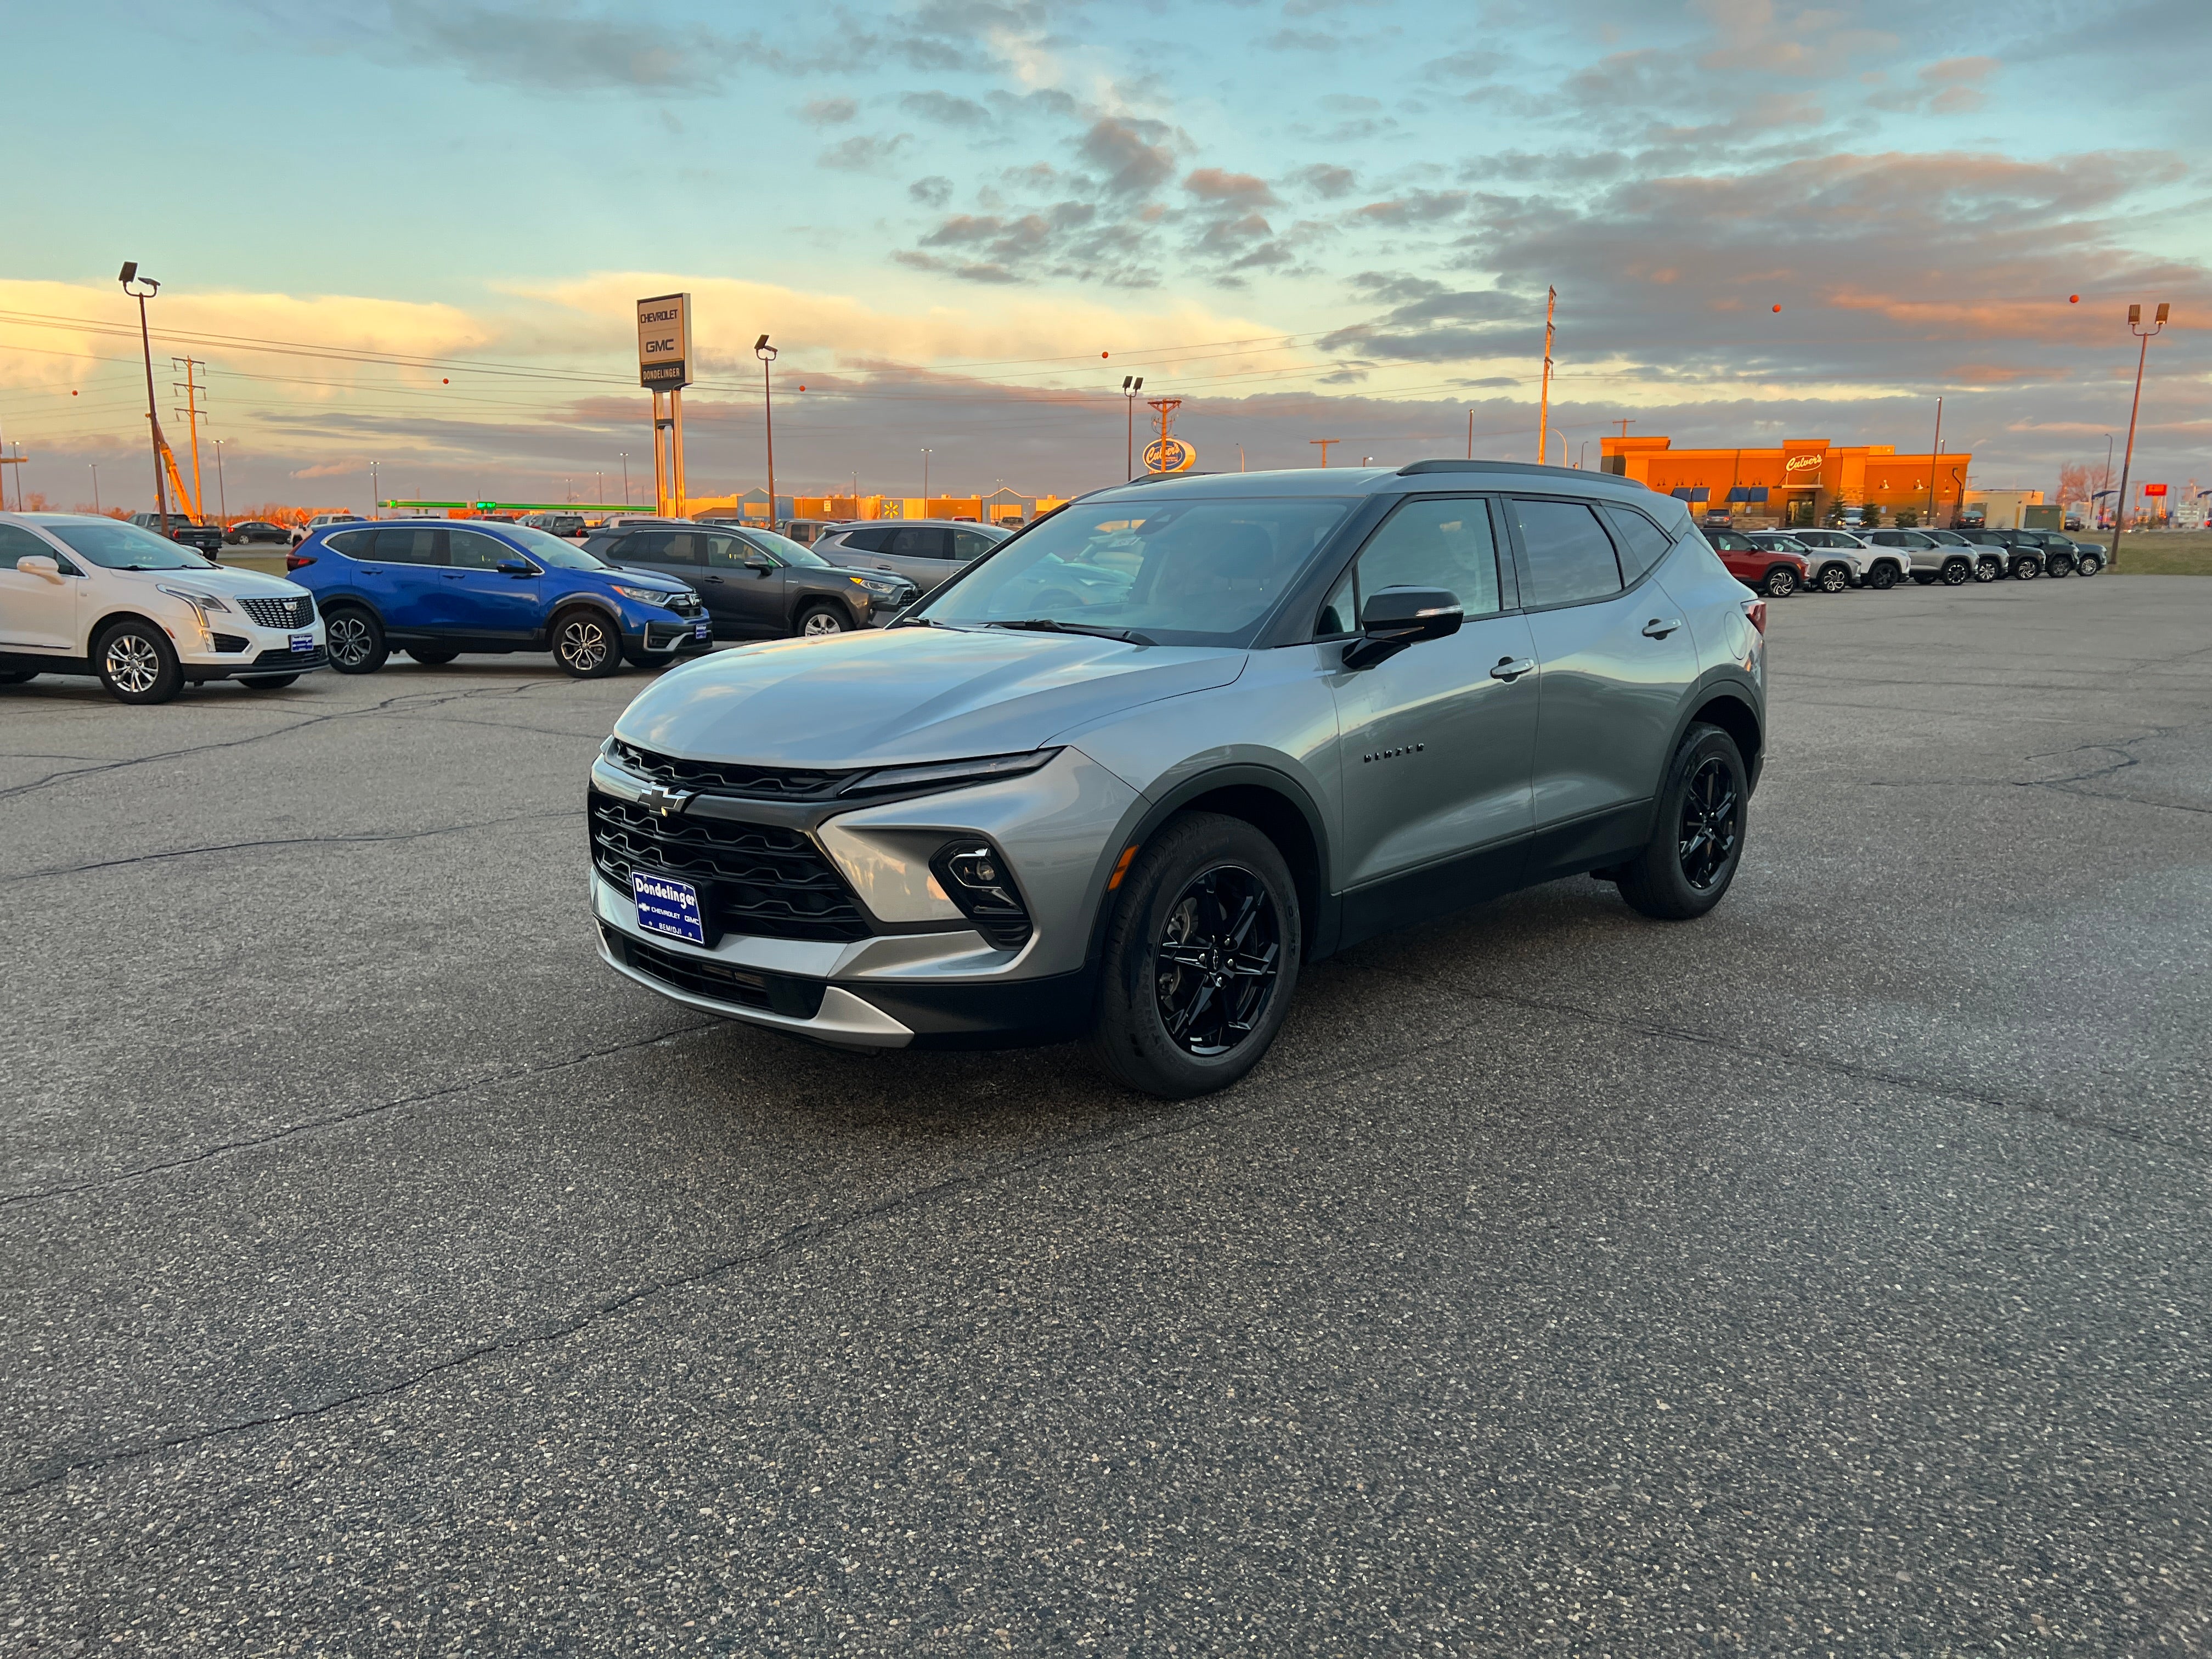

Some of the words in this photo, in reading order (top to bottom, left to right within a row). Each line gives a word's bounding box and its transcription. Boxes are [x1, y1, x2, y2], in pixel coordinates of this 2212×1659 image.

[640, 309, 678, 324] CHEVROLET
[646, 338, 674, 353] GMC
[643, 367, 680, 380] DONDELINGER
[1786, 454, 1822, 472] Culver's
[1364, 743, 1425, 763] BLAZER
[635, 877, 696, 909] Dondelinger
[651, 906, 681, 920] CHEVROLET
[684, 915, 700, 926] GMC
[658, 922, 682, 935] BEMIDJI
